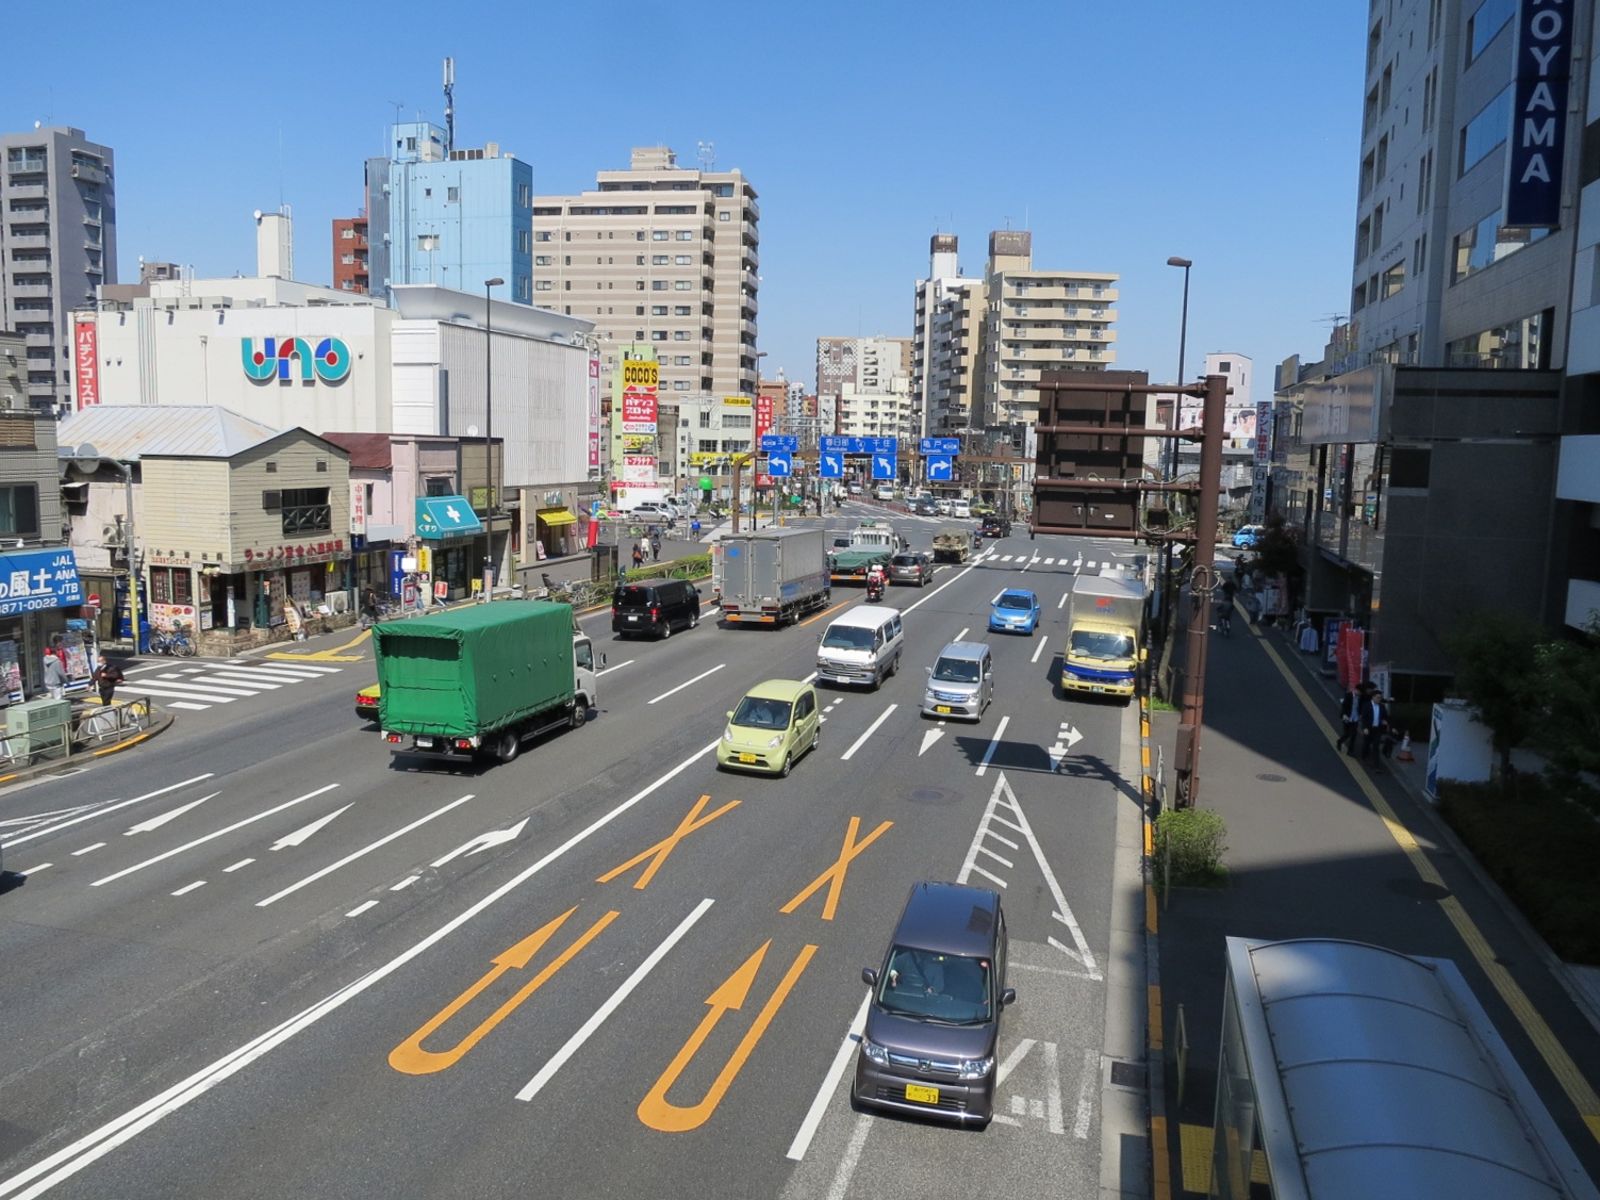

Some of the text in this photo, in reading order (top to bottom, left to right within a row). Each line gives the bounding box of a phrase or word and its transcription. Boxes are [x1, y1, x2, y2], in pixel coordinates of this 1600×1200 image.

[1520, 0, 1563, 183] OYAMA
[624, 366, 658, 384] COCO'S
[625, 396, 654, 407] パチンコ
[625, 406, 654, 415] スロット
[418, 524, 437, 533] くすり
[52, 555, 73, 567] JAL
[55, 569, 77, 581] ANA
[57, 583, 78, 595] JTB
[0, 597, 58, 614] 871-0022
